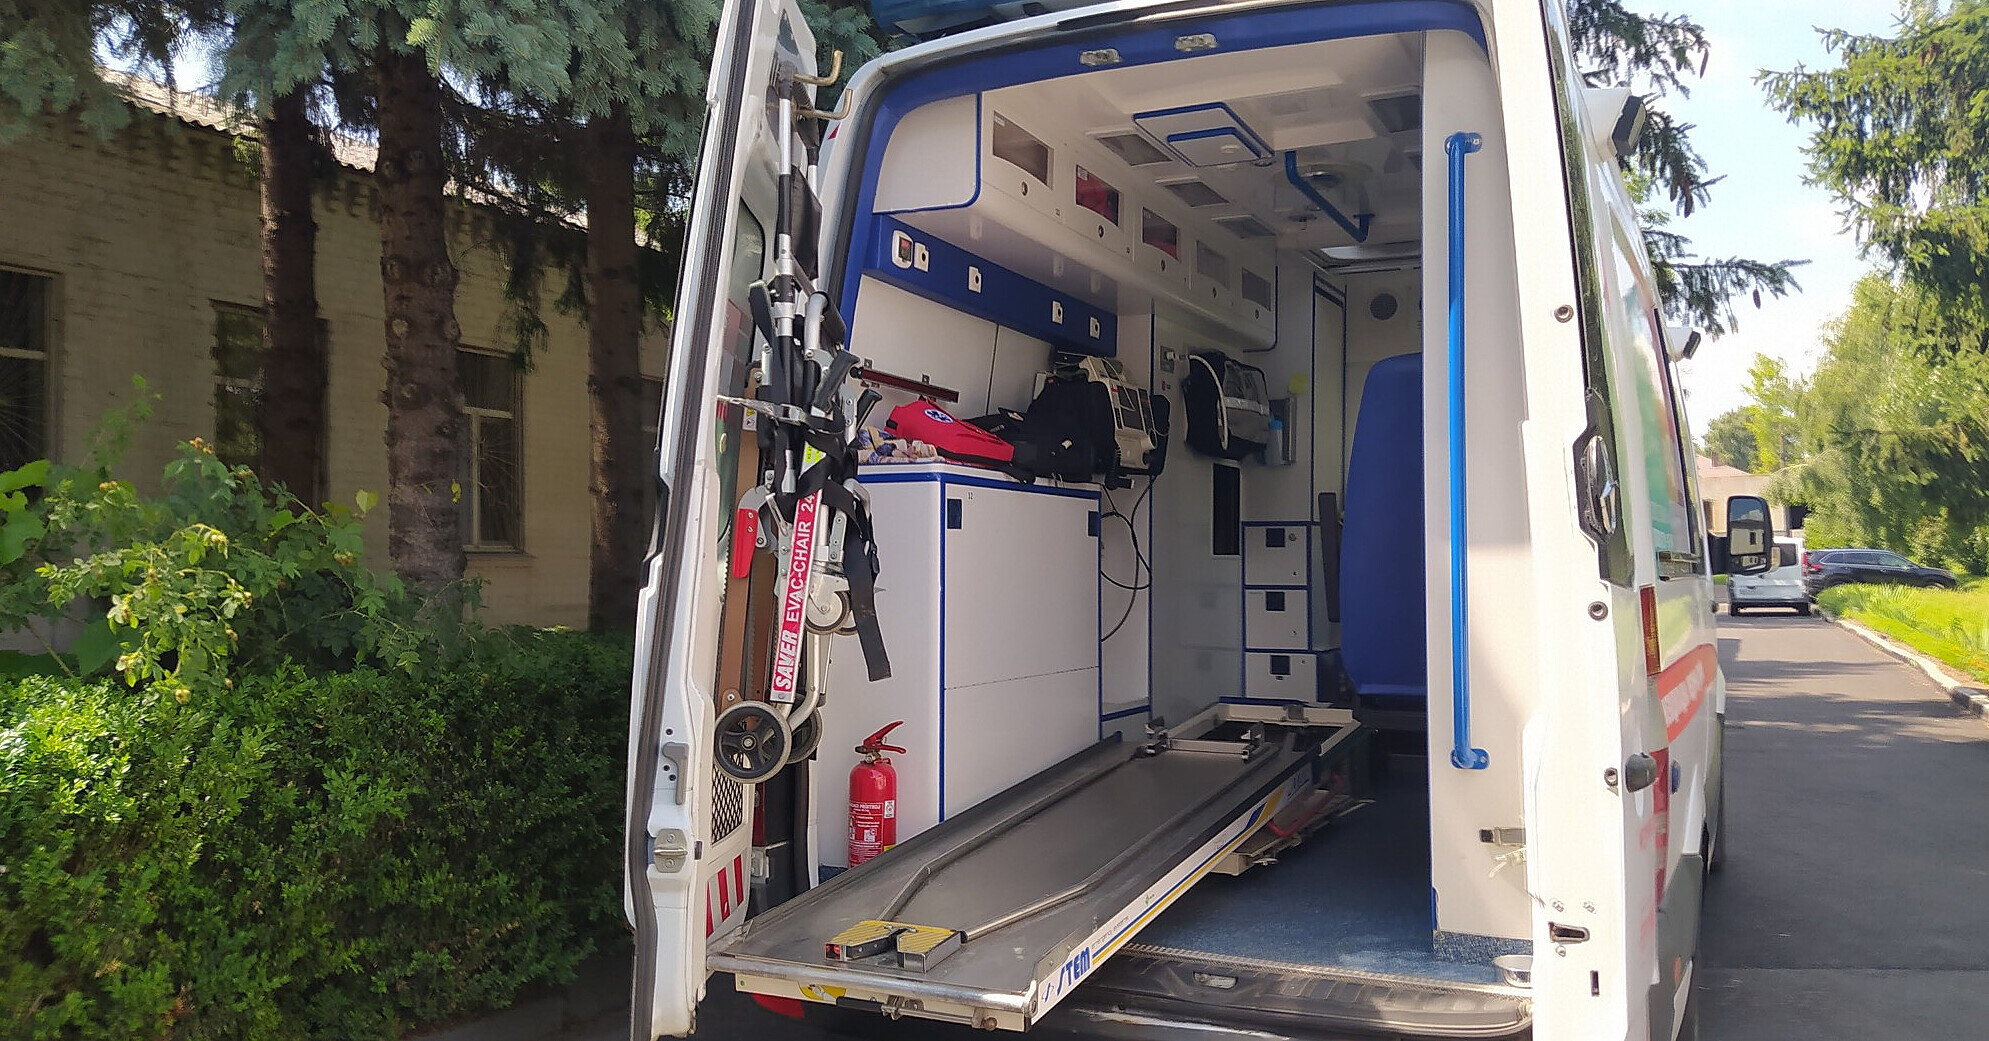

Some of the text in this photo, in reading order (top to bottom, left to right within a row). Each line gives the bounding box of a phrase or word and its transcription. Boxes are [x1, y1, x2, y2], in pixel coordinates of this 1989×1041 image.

[786, 521, 812, 623] EVAC-CHAIR
[776, 629, 798, 690] SAVER
[1057, 946, 1090, 996] STEM
